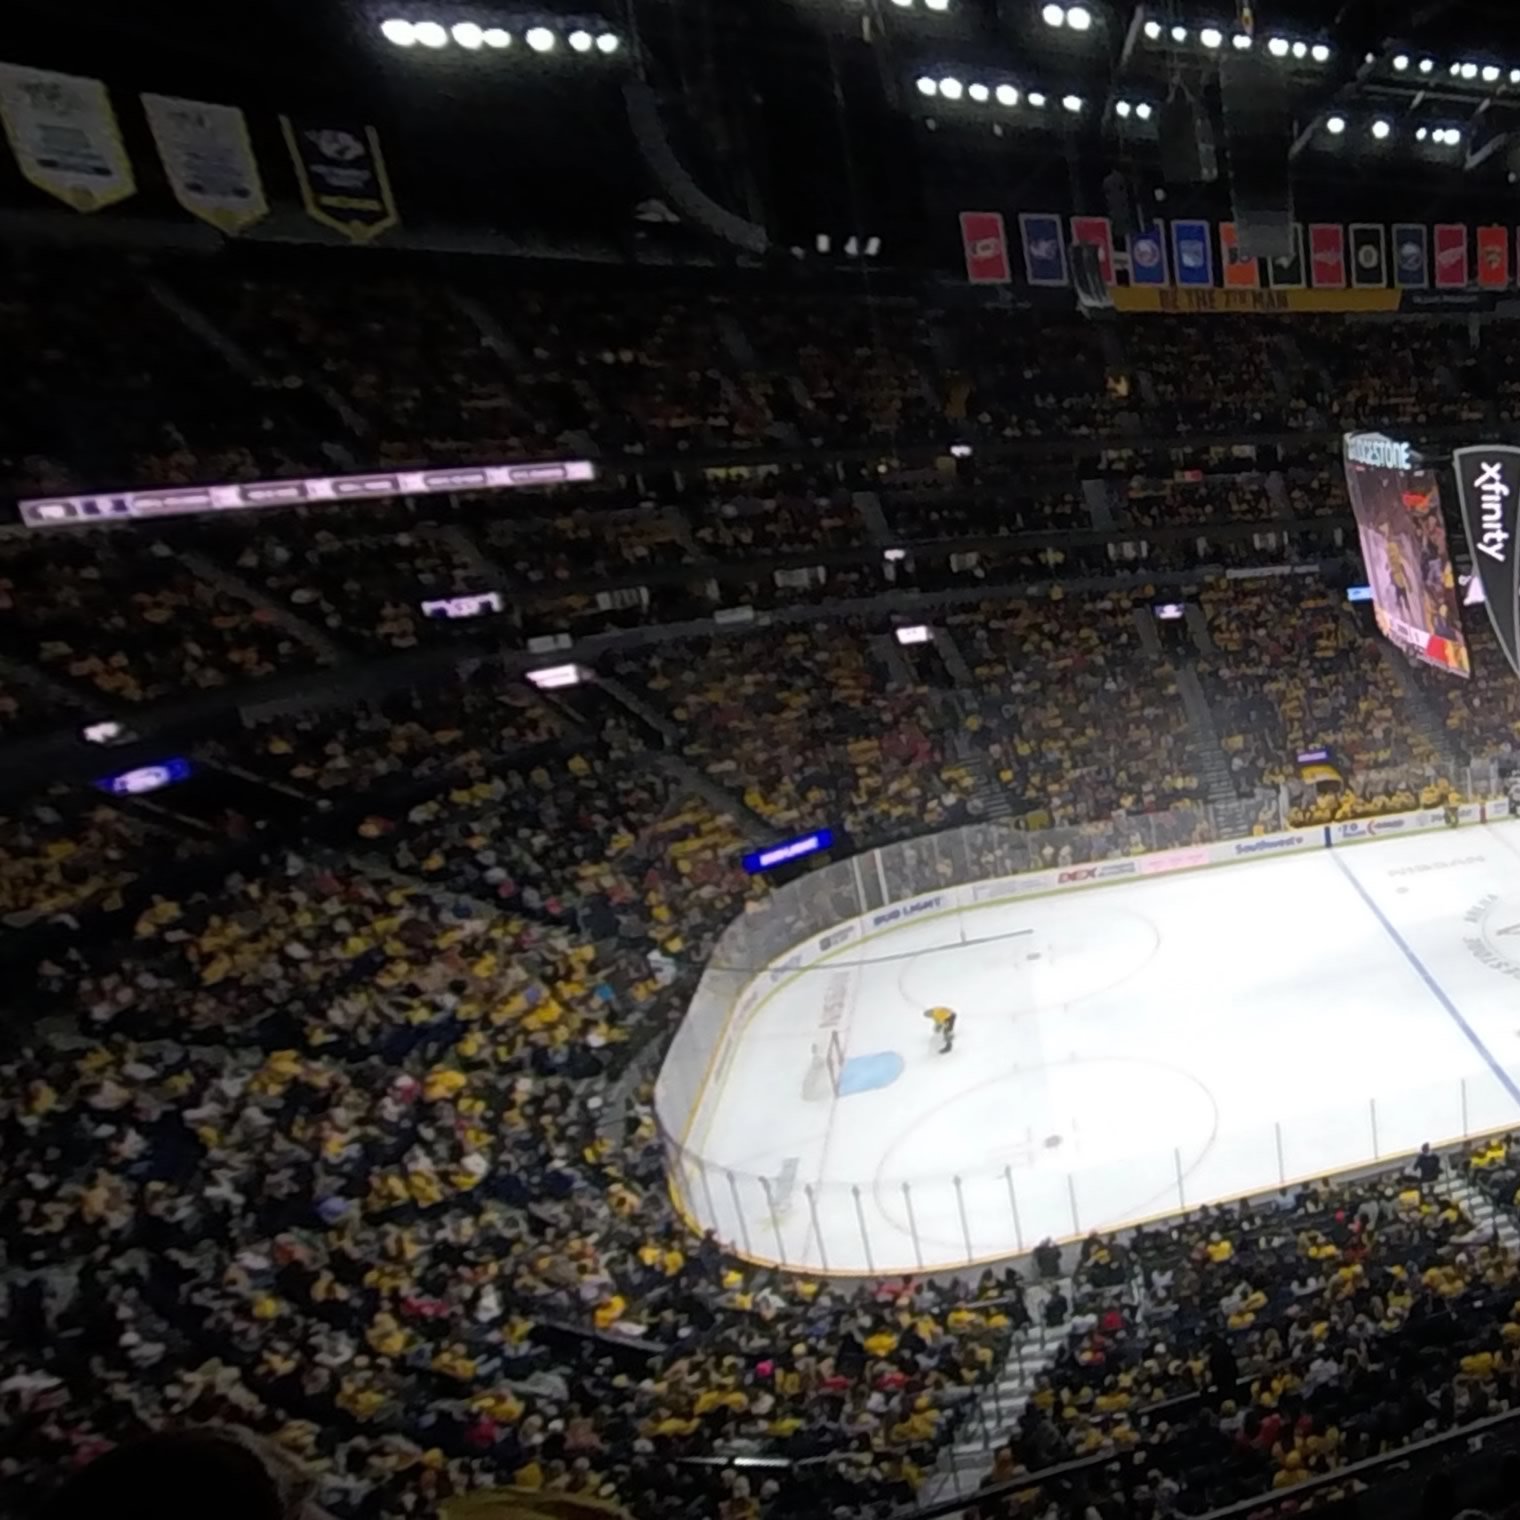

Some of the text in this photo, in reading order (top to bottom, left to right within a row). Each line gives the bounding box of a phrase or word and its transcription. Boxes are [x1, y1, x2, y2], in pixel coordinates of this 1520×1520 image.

[1184, 288, 1216, 309] THE
[1251, 288, 1290, 308] MAN
[1473, 461, 1510, 563] xfinity
[1057, 866, 1098, 885] DEX
[903, 896, 943, 918] LIGHT
